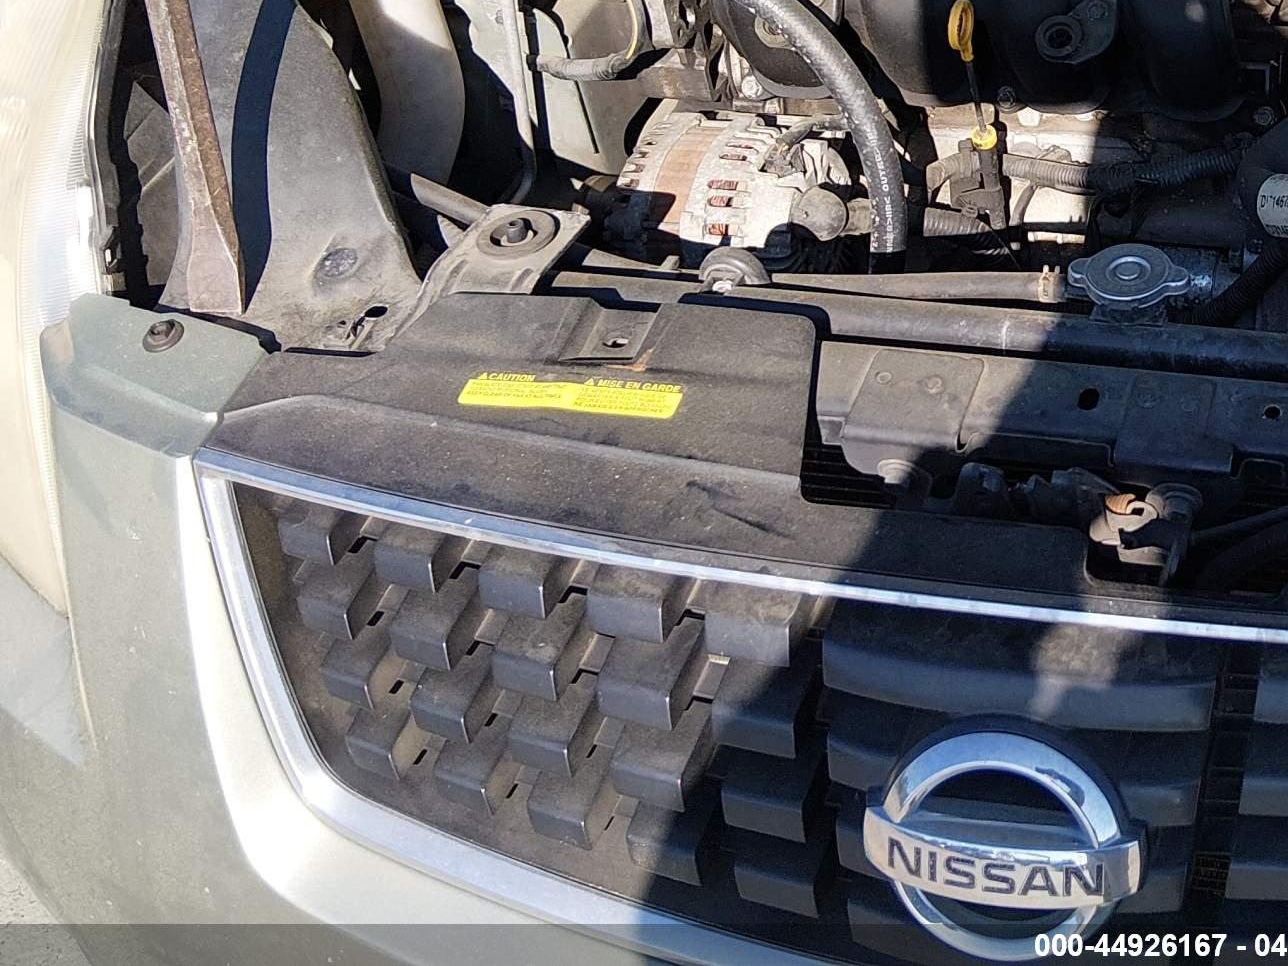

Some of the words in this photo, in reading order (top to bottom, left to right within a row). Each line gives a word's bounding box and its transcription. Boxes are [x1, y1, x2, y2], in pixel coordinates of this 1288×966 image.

[487, 372, 537, 383] CAUTION
[597, 378, 626, 389] MISE
[625, 381, 643, 390] EN
[642, 382, 682, 393] GARDE
[886, 836, 1105, 898] NISSAN
